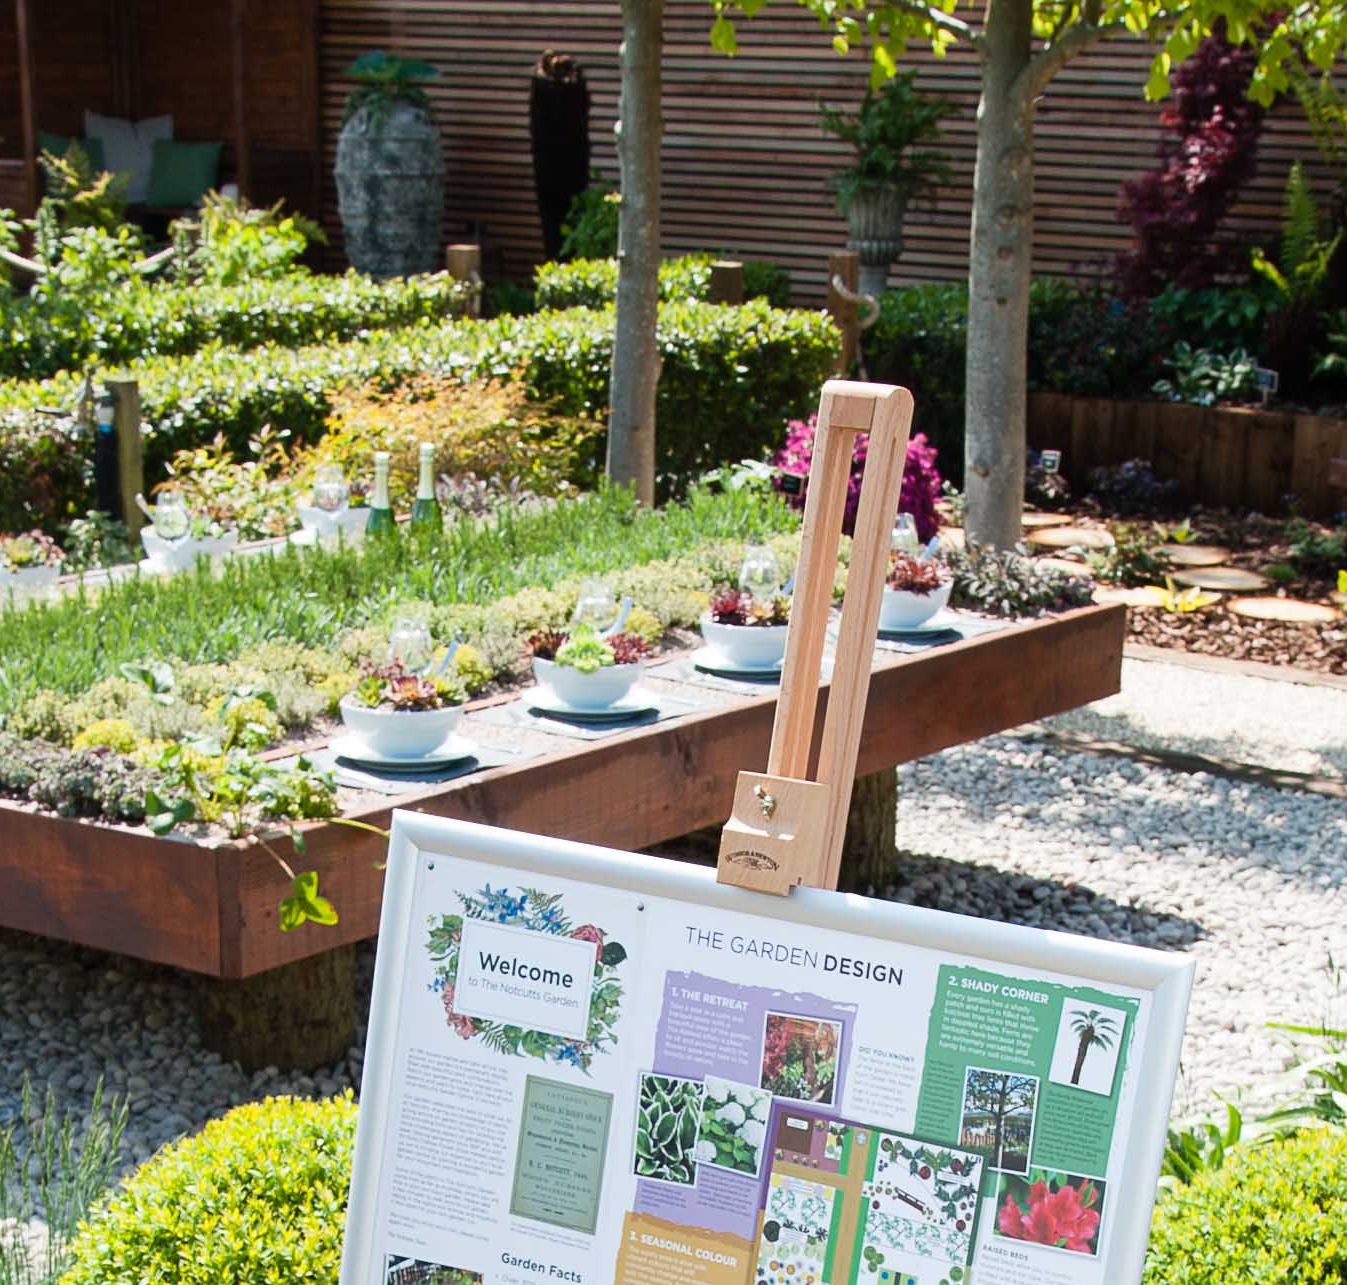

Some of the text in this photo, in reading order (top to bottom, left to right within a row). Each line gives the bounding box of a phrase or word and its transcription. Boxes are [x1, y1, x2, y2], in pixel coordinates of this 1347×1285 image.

[477, 950, 574, 989] Welcome
[683, 925, 903, 986] THE GARDEN DESIGN
[467, 975, 579, 1009] to The Notcutts Garden
[671, 986, 748, 1012] 1. THE RETREAT
[948, 974, 1049, 1004] 2. SHADY CORNER
[872, 1049, 887, 1057] YOU
[888, 1052, 914, 1063] KNOW?
[640, 1233, 693, 1256] SEASONAL
[695, 1247, 737, 1267] COLOUR
[982, 1244, 1028, 1261] RAISED BEDS
[501, 1251, 582, 1283] Garden Facts
[501, 1273, 519, 1285] Over
